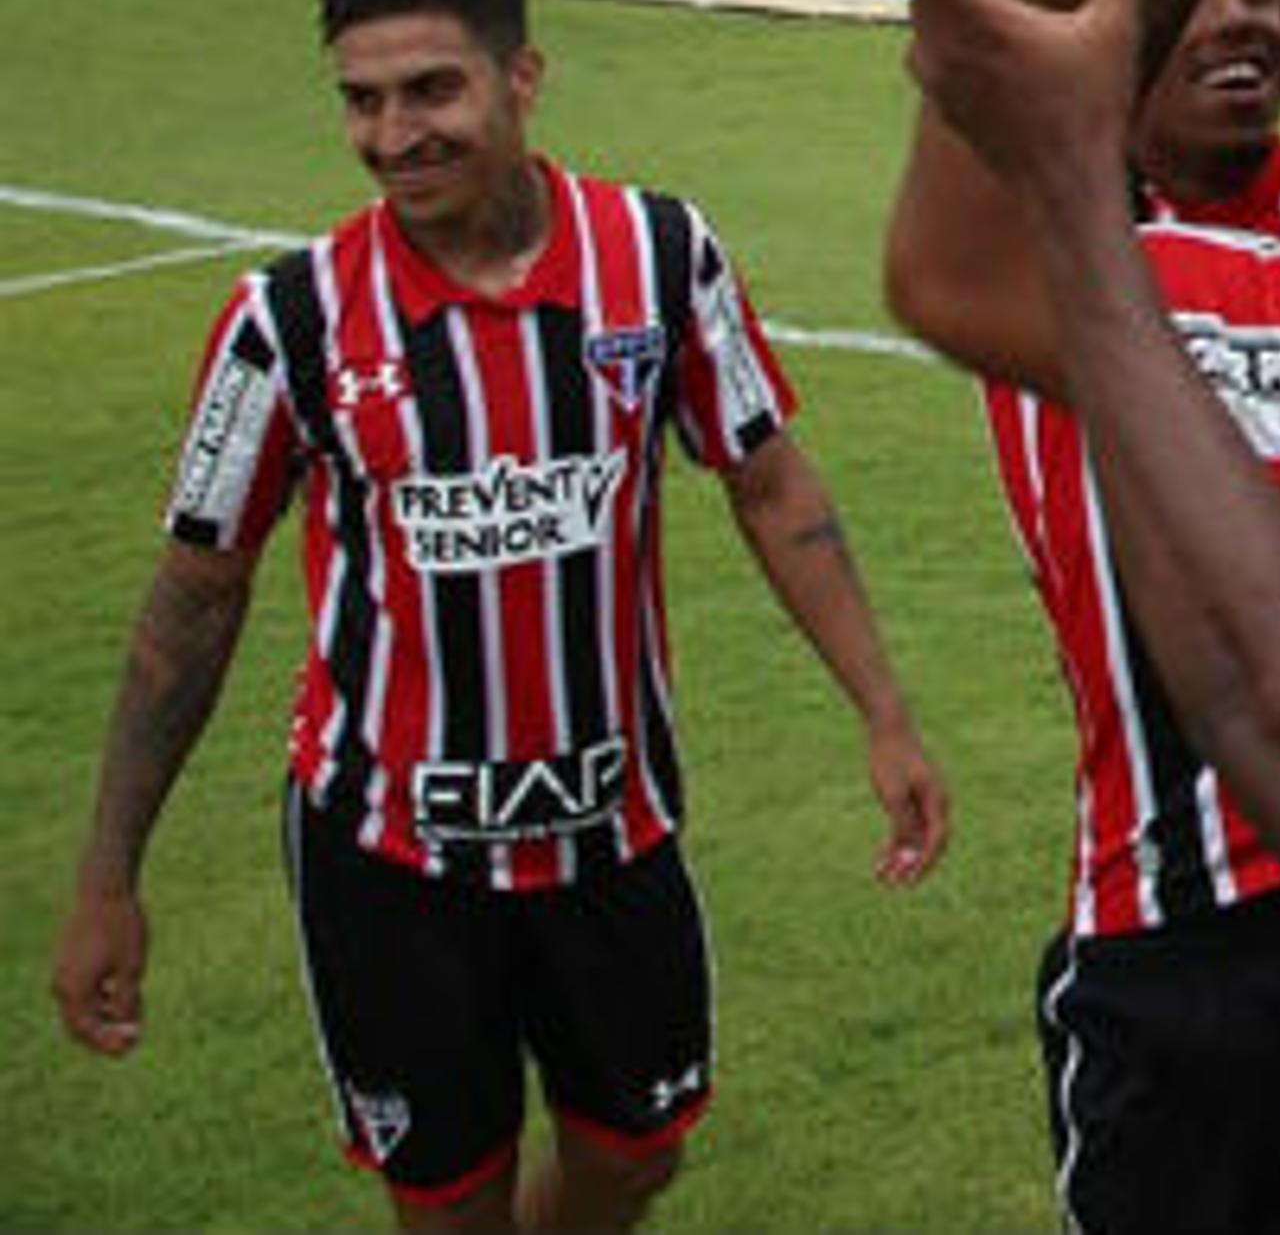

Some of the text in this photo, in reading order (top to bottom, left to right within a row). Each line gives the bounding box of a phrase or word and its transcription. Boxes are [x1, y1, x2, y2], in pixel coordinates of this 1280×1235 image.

[399, 462, 577, 519] PREVENT
[416, 516, 565, 560] SENIOR
[414, 737, 627, 827] FIAP
